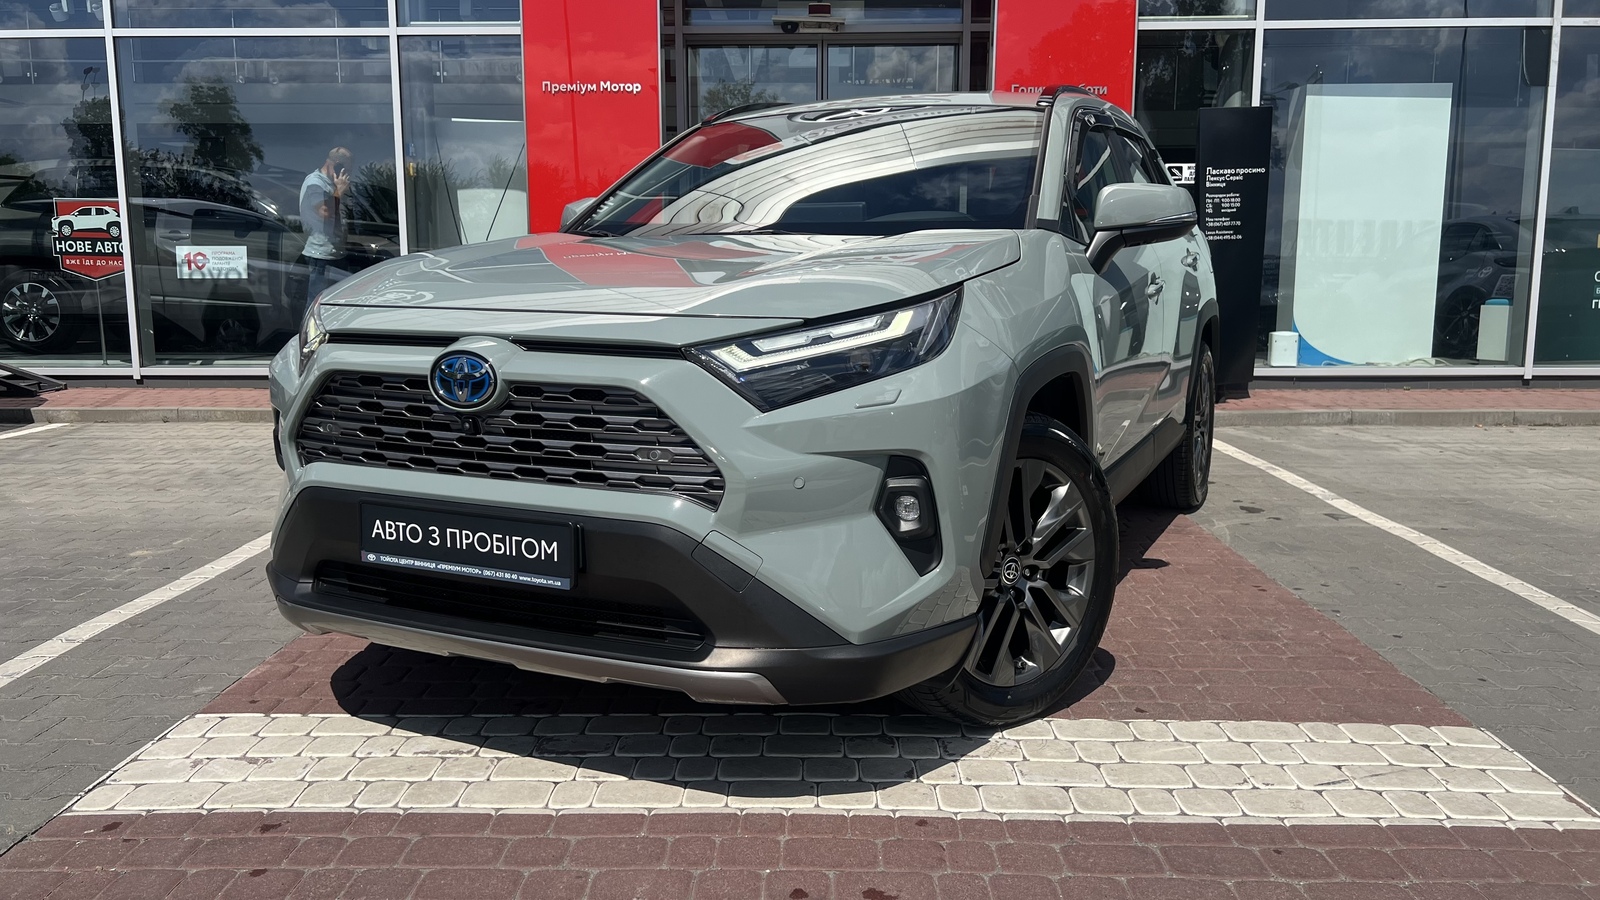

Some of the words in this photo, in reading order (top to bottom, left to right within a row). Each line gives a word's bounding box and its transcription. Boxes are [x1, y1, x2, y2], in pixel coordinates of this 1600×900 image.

[542, 80, 597, 94] Преміум
[600, 81, 642, 94] Мотор
[56, 240, 92, 252] НОВЕ
[372, 519, 422, 544] АВТО
[428, 526, 440, 546] З
[446, 528, 558, 562] ПРОБІГОМ
[380, 555, 398, 563] ТОЙОТА
[414, 560, 435, 568] ВІННИЦЯ
[437, 563, 461, 572] «ПРЕМІУМ
[462, 566, 482, 574] МОТОР»
